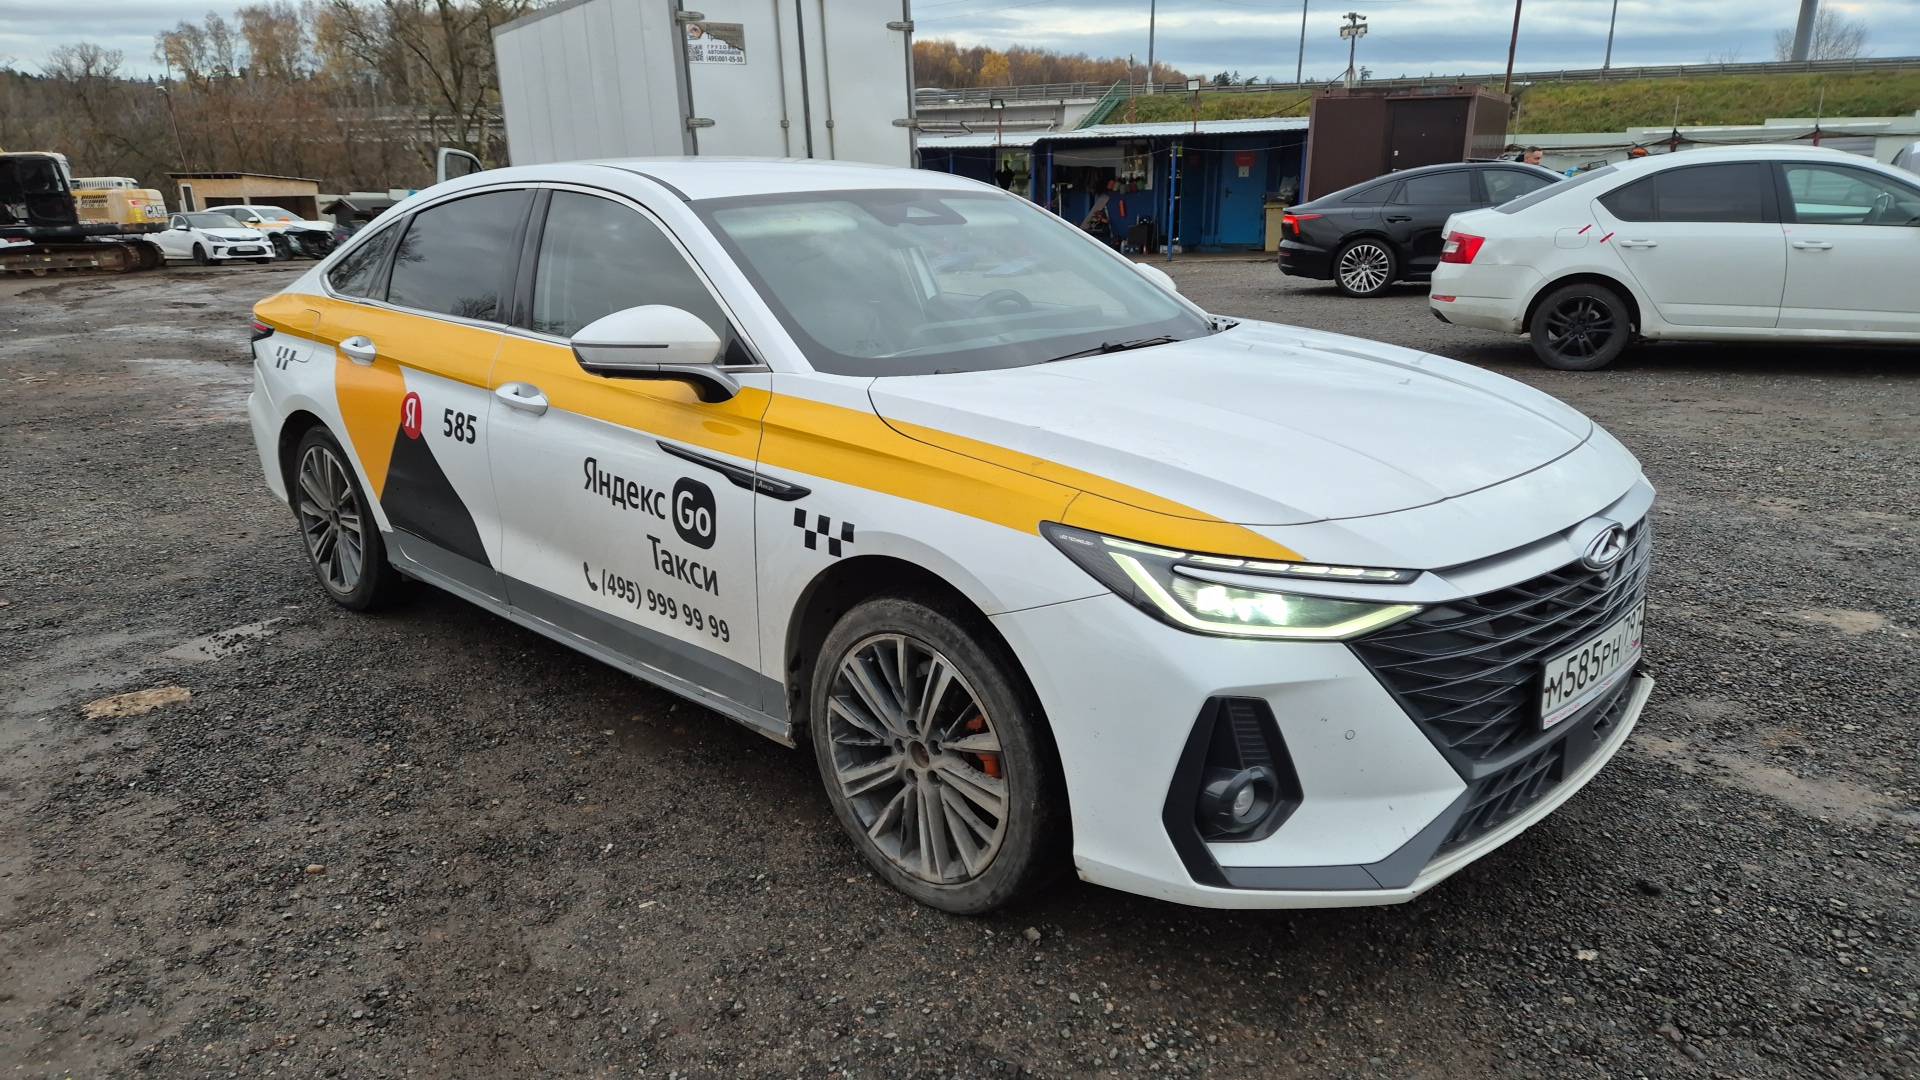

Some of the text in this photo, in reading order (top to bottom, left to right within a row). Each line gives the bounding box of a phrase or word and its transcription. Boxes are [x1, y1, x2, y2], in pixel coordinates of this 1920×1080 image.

[405, 398, 416, 429] Я
[443, 408, 477, 444] 585
[583, 456, 711, 537] Яндекс Go
[646, 533, 719, 596] Такси
[602, 568, 730, 643] (495) 999 99 99
